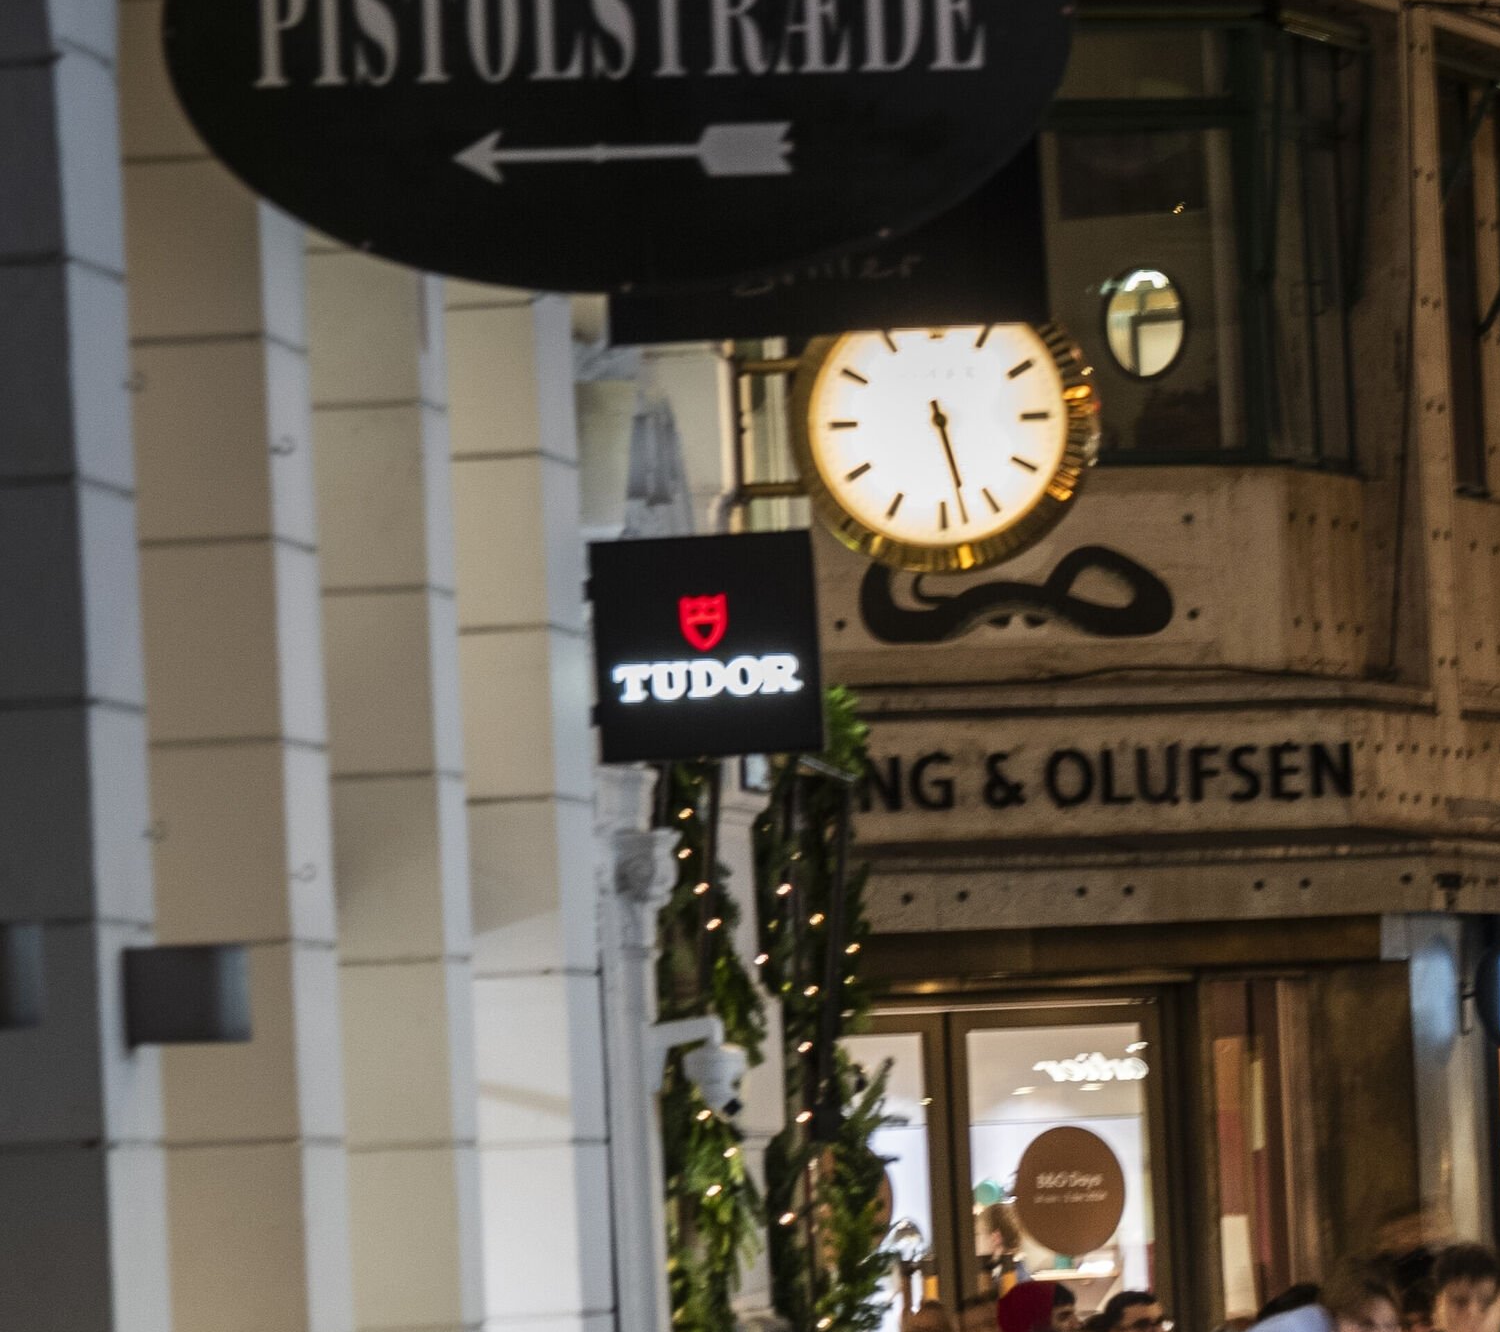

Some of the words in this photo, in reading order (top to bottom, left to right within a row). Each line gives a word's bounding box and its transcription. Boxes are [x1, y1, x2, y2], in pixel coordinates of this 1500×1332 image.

[612, 652, 804, 704] TUDOR
[856, 751, 956, 813] NG
[984, 751, 1027, 810] &
[1045, 741, 1353, 809] OLUFSEN
